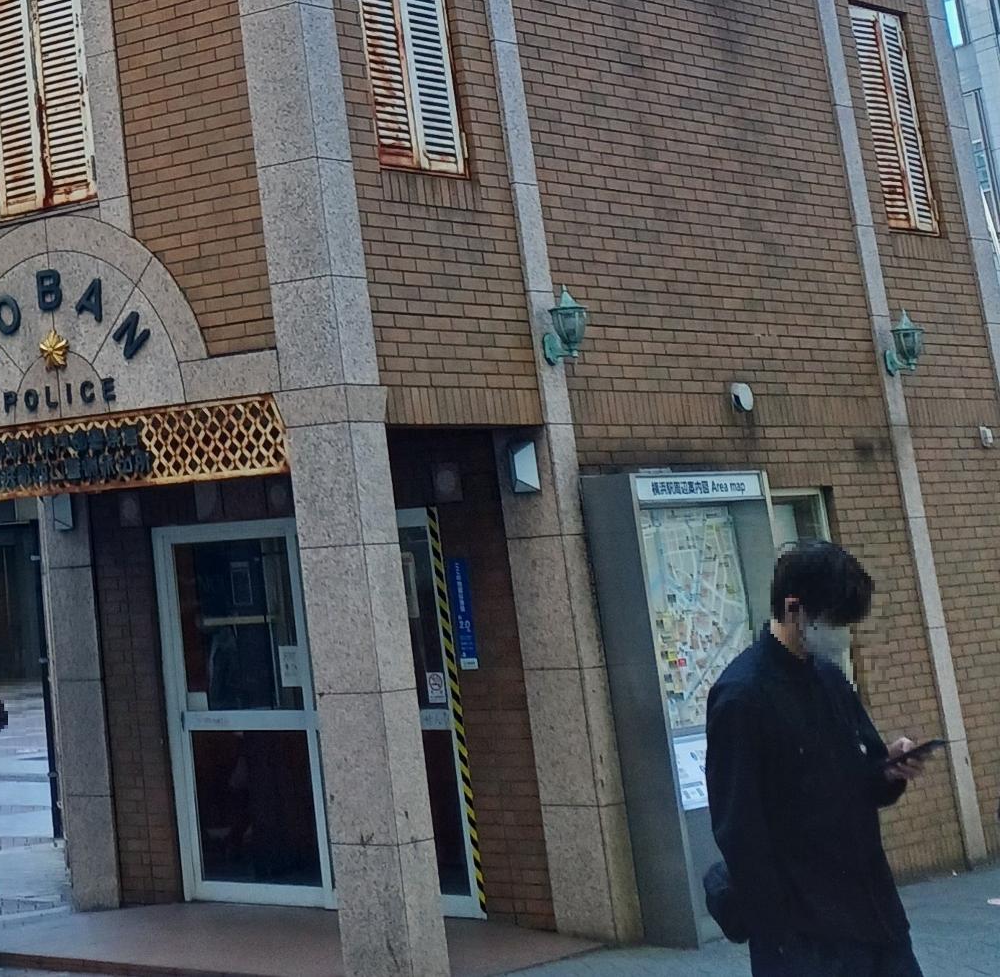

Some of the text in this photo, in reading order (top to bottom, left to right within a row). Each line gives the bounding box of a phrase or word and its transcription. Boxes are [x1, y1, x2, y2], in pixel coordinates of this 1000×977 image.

[3, 377, 117, 413] POLICE
[711, 480, 746, 495] Area map
